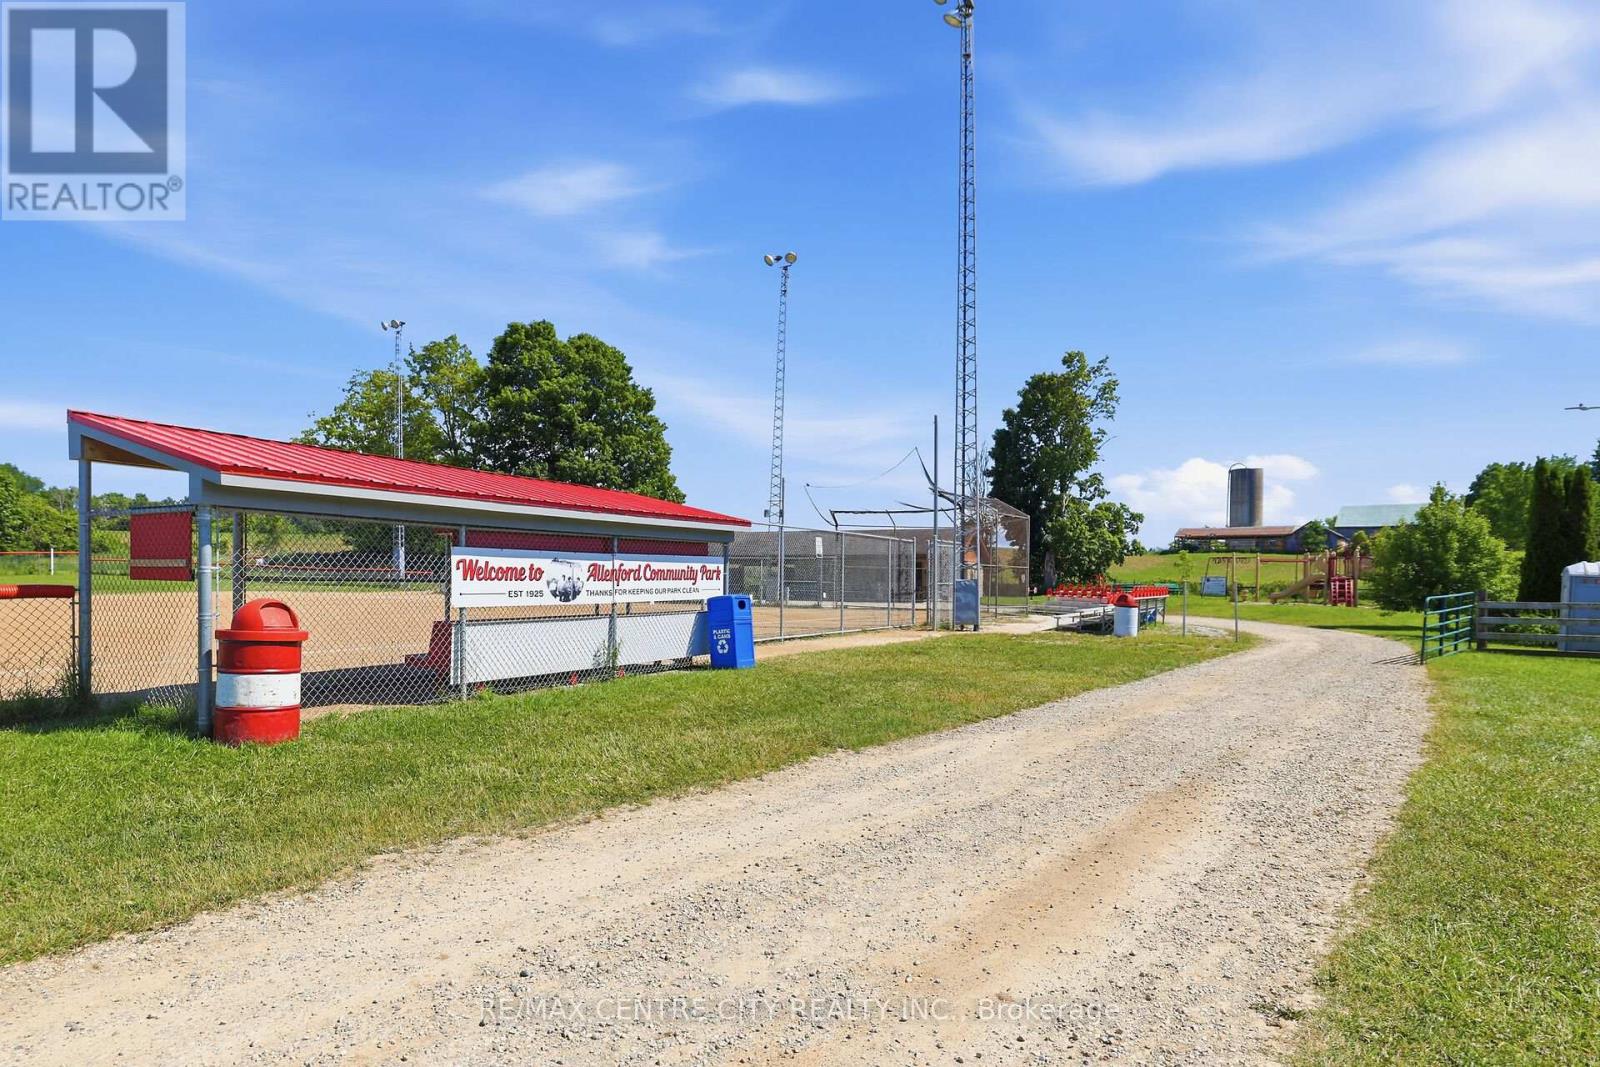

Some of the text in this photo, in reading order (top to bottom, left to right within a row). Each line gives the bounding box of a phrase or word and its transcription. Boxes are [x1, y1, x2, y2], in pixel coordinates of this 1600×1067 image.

[456, 559, 721, 587] Welcome to Allenford Community Park
[508, 590, 544, 598] EST 1925
[586, 589, 613, 597] THANKS
[614, 588, 627, 596] FOR
[628, 588, 654, 596] KEEPING
[683, 586, 700, 594] CLEAN
